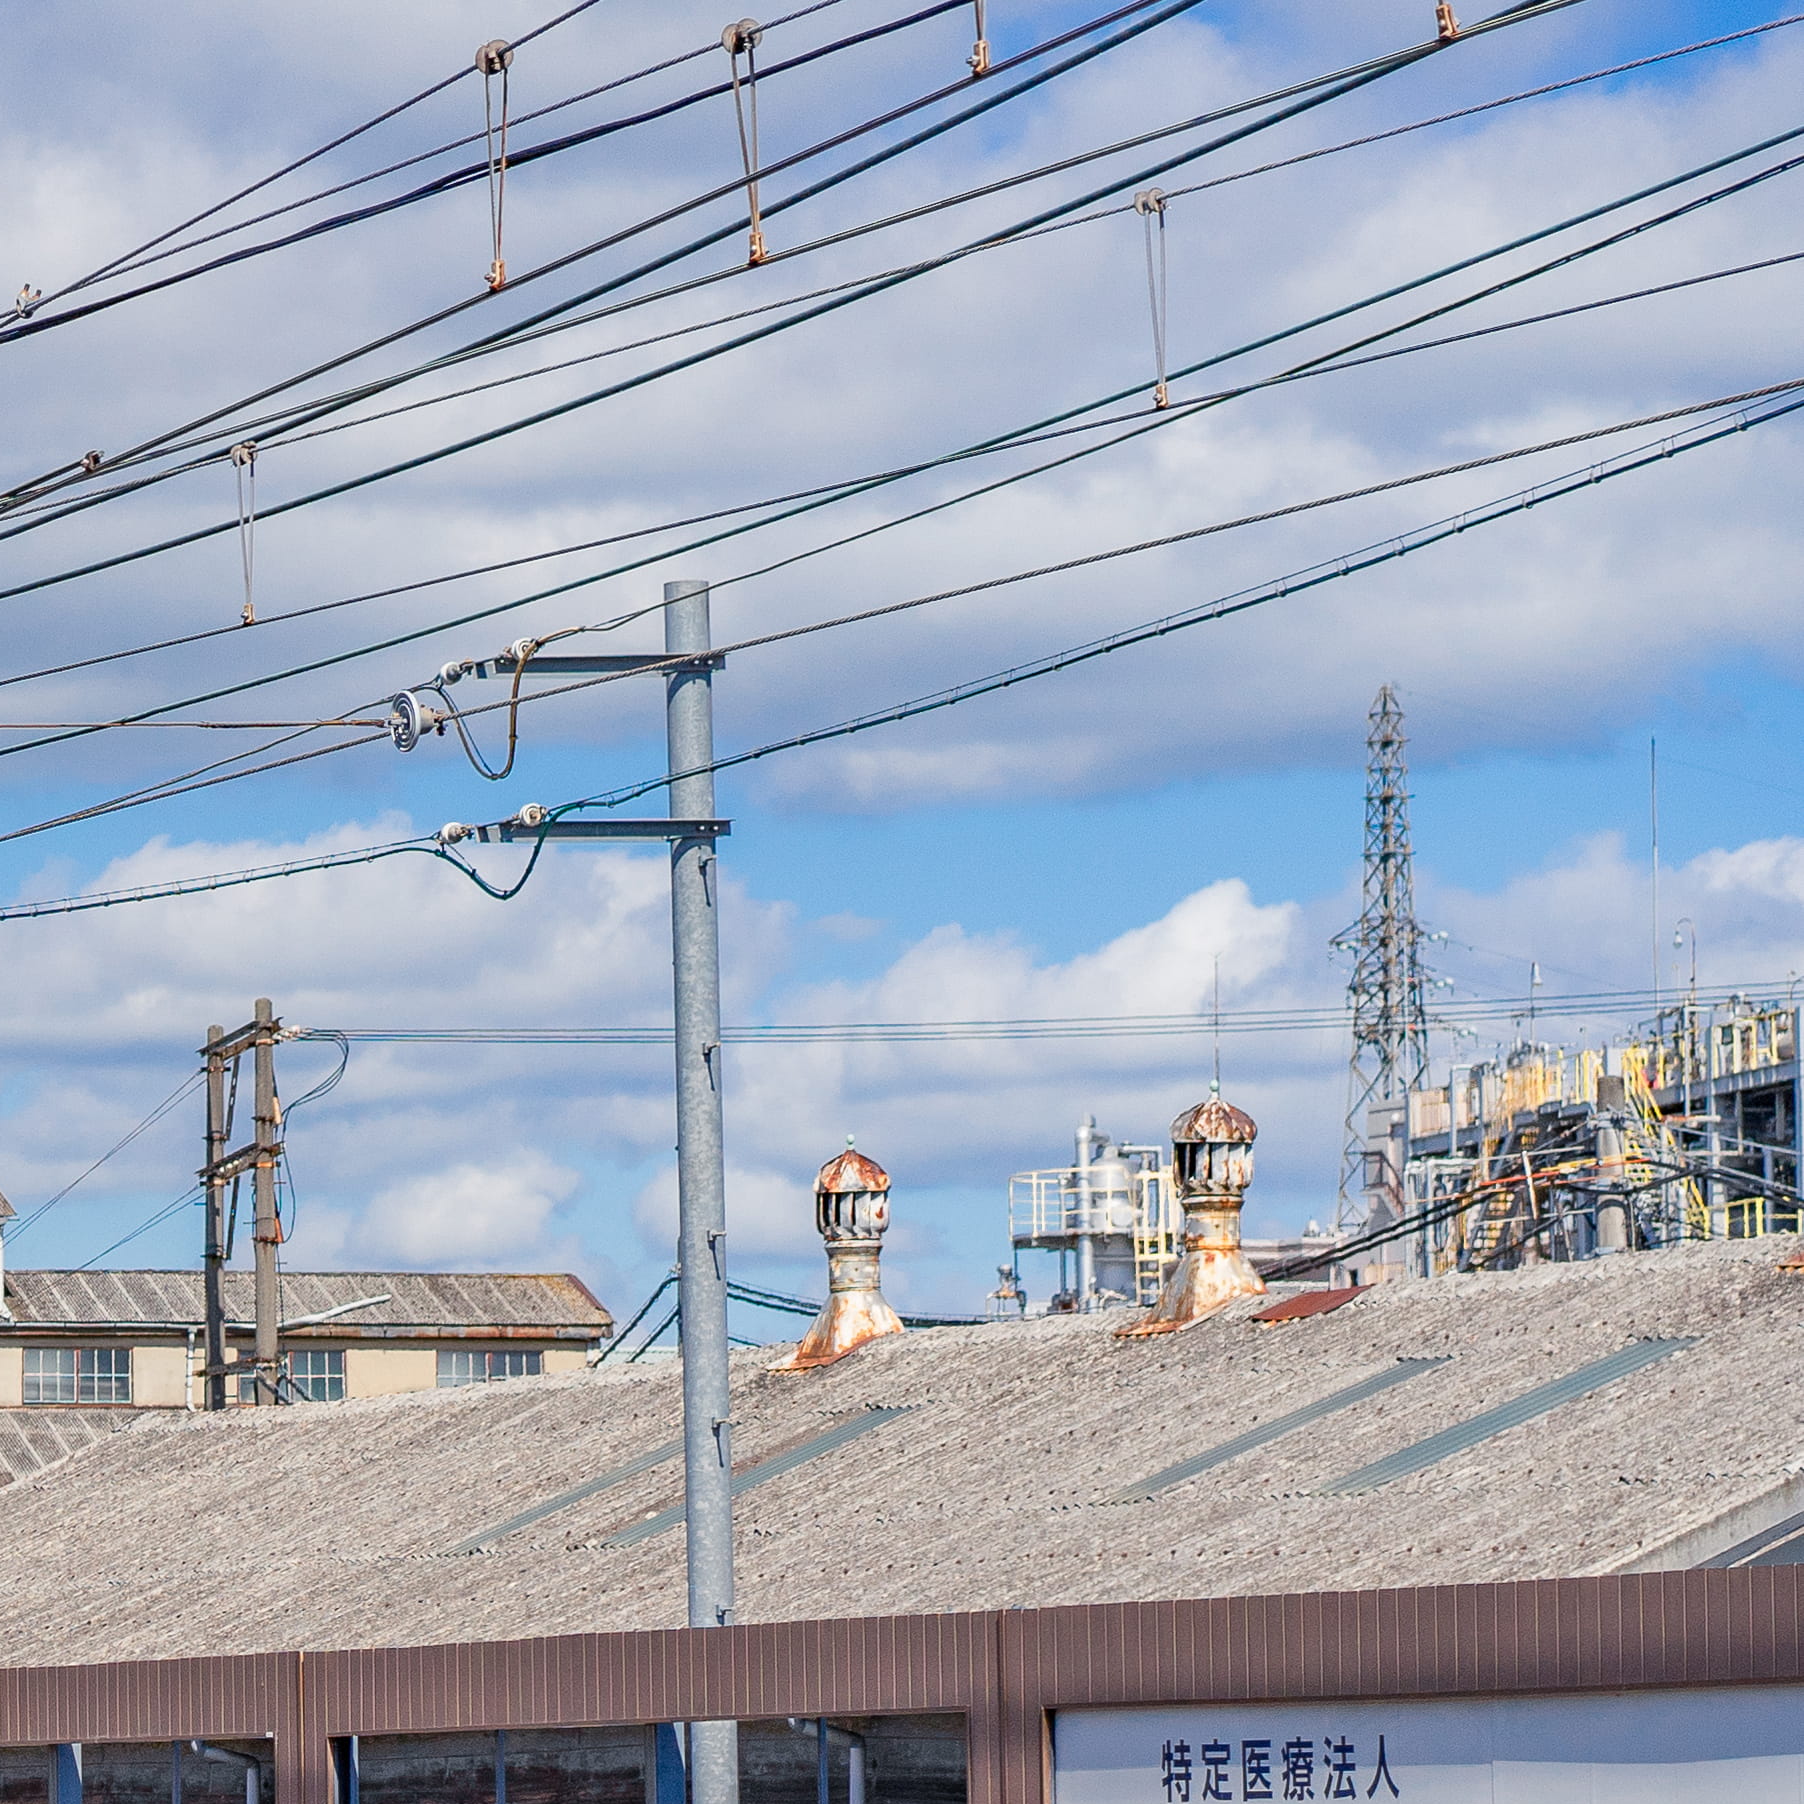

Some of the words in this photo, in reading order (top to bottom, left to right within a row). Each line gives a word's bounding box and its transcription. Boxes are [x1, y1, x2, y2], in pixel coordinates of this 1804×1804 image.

[1161, 1735, 1400, 1803] 特定医療法人
